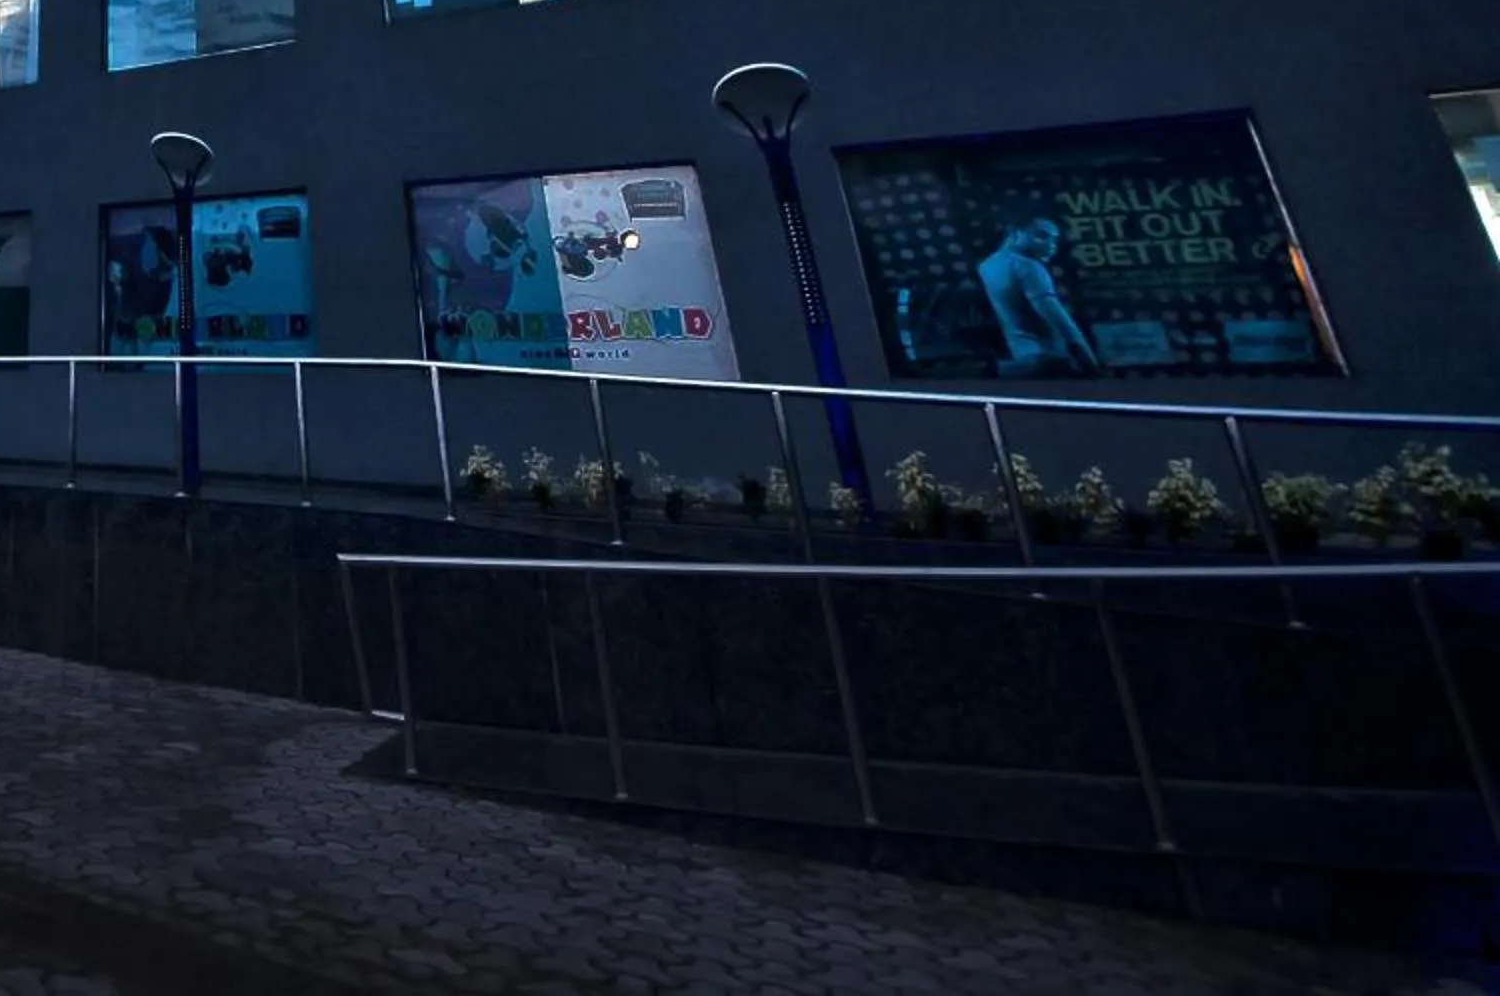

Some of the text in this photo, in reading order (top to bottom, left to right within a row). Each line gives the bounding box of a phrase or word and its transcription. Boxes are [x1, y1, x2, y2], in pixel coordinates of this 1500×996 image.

[1064, 186, 1181, 214] WALK
[1067, 209, 1226, 242] FIT OUT
[1075, 237, 1238, 267] BETTER
